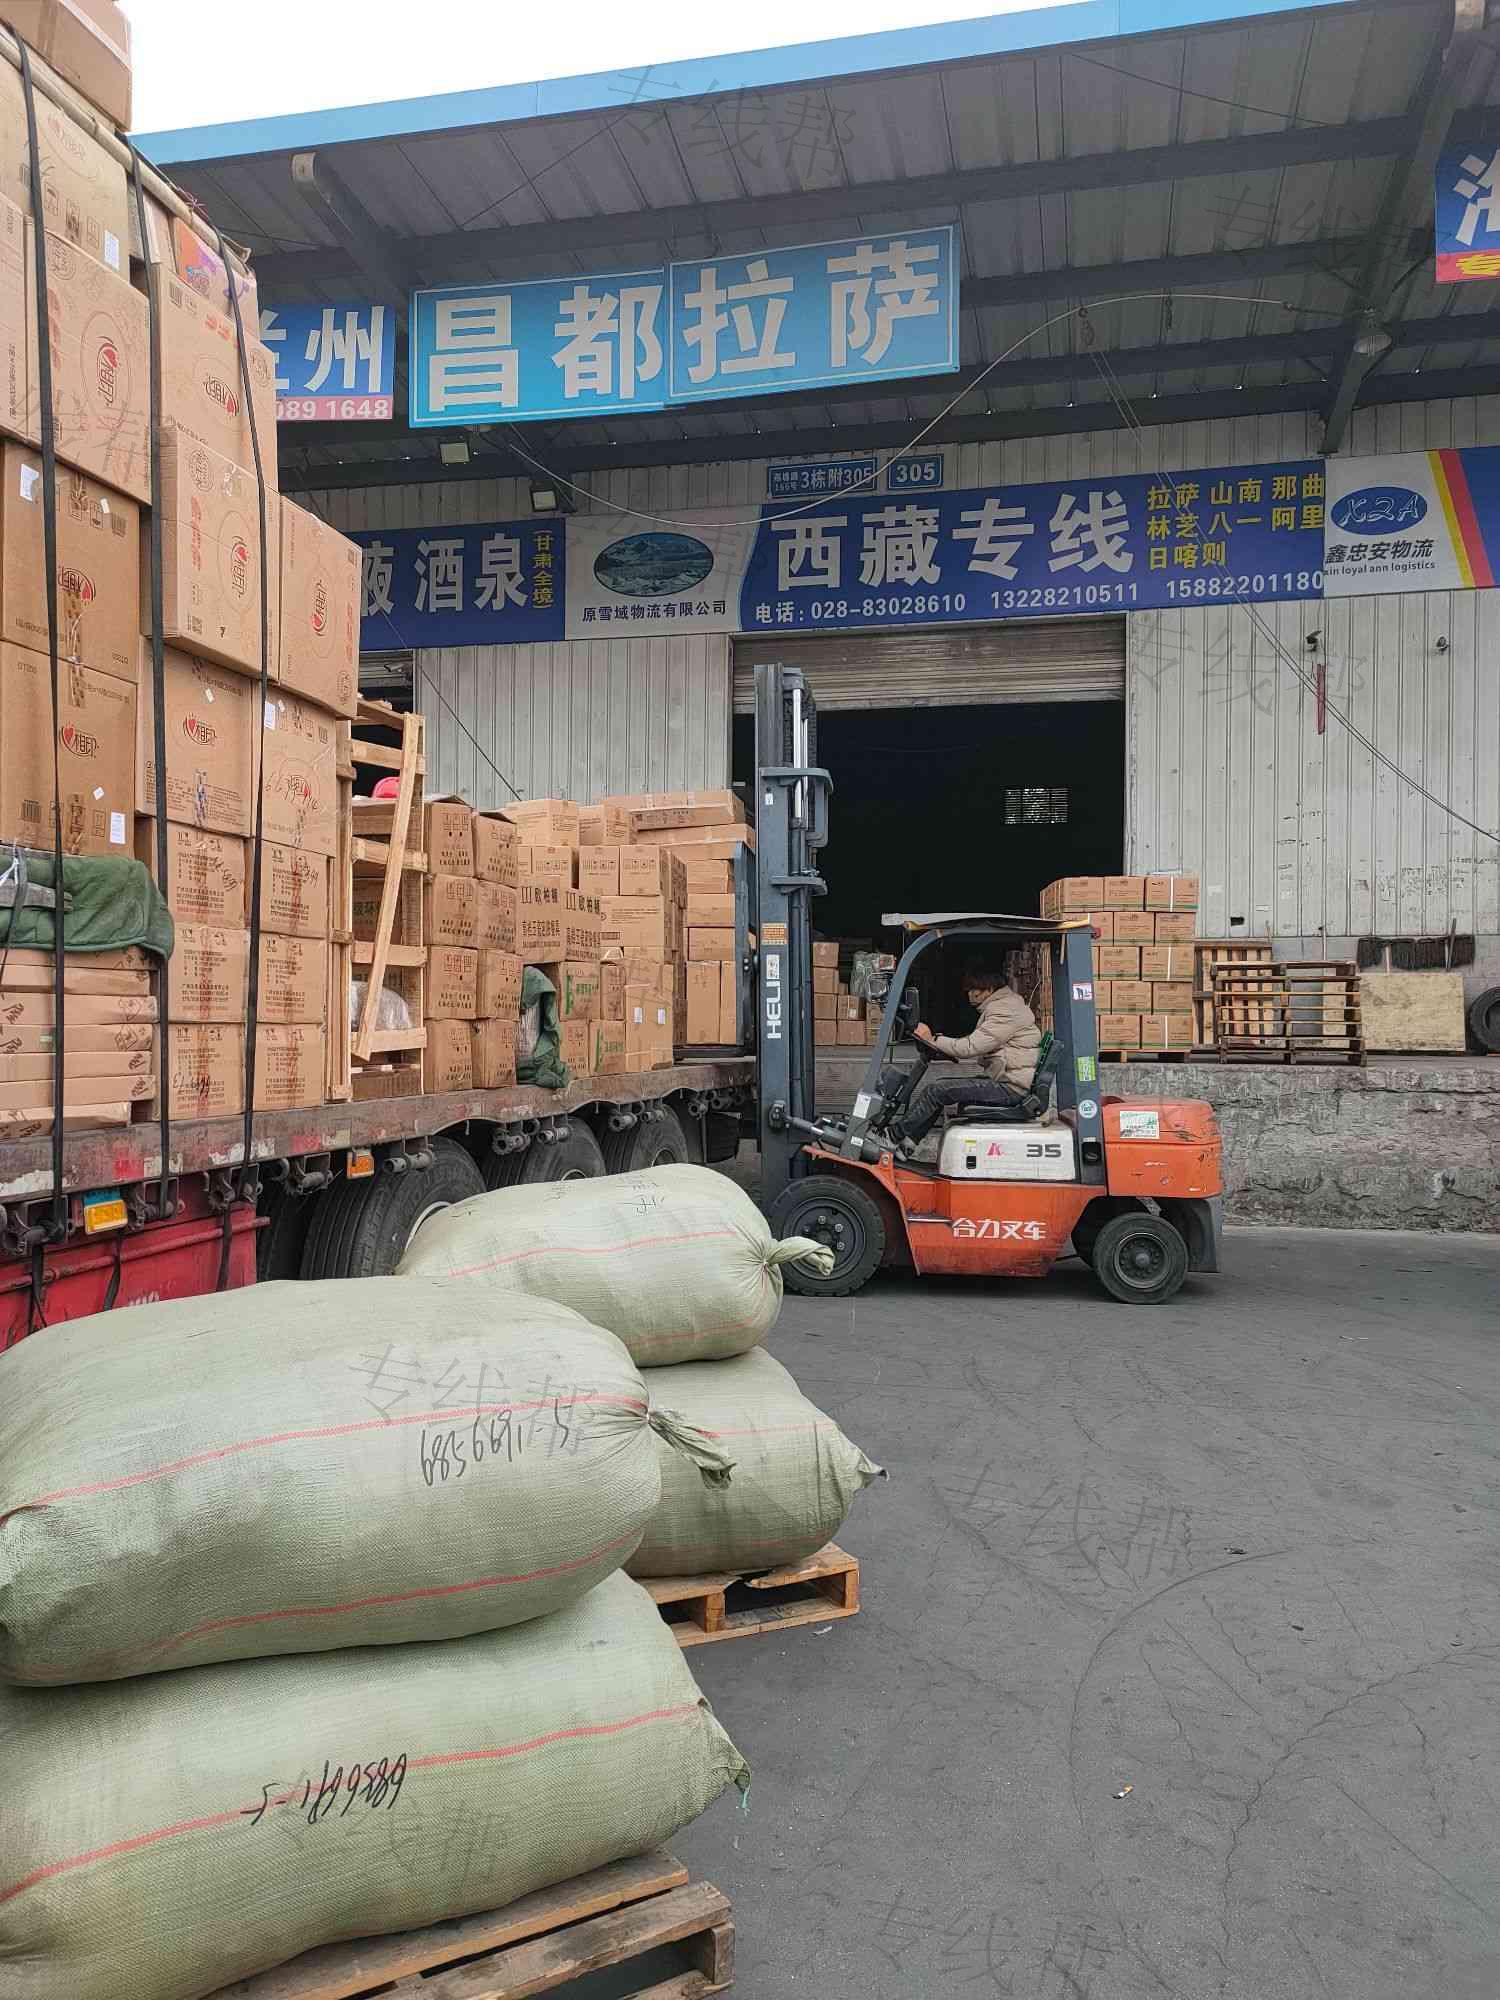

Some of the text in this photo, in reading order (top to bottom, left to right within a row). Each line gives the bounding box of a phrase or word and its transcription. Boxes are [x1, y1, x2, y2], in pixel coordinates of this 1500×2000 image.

[326, 399, 388, 420] 1648
[896, 463, 935, 482] 305
[1147, 473, 1325, 510] 拉萨 山南 那曲
[1147, 505, 1324, 541] 林芝 八一 阿里
[770, 491, 1134, 592] 西藏专线
[1325, 539, 1434, 564] 鑫忠安物流
[1149, 541, 1226, 570] 日喀则
[1391, 560, 1436, 574] logistics
[991, 583, 1138, 609] 13228210511
[1166, 570, 1323, 599] 15882201180
[581, 601, 727, 622] 原雪域物流有限公司
[766, 979, 782, 1039] HELI
[1026, 1143, 1062, 1158] 35
[952, 1217, 1047, 1241] 合力叉车
